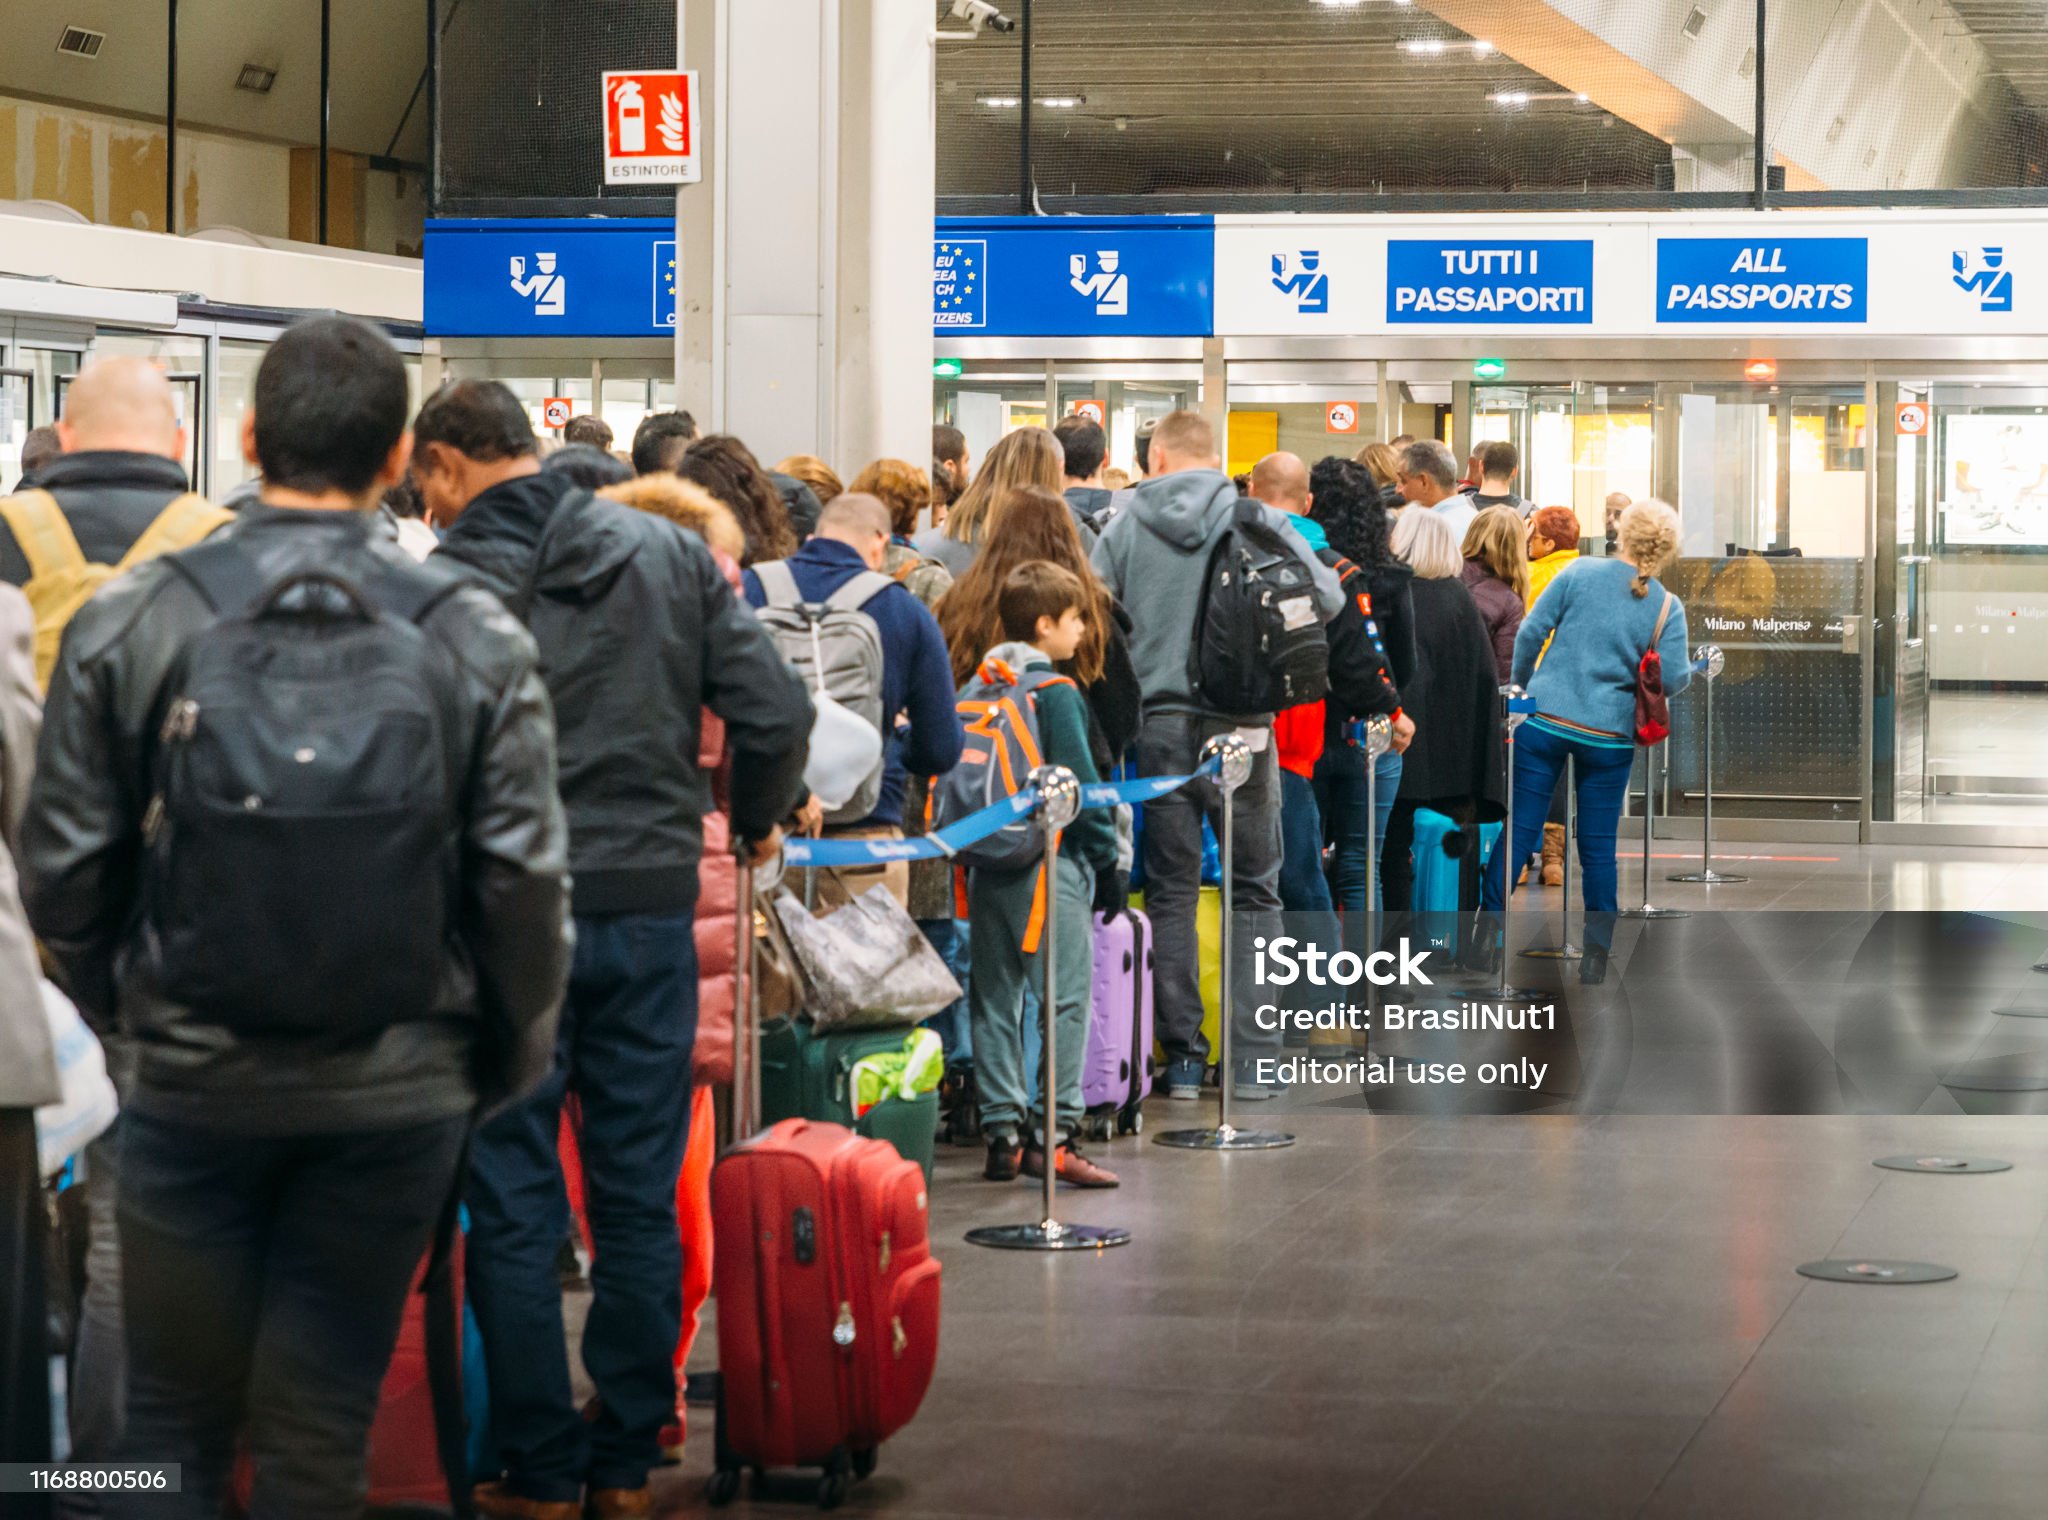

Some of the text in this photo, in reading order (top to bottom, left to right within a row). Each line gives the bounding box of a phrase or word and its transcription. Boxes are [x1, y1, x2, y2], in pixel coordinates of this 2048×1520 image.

[612, 164, 688, 177] ESTINTORE
[936, 256, 955, 267] EU
[1441, 250, 1537, 275] TUTTI I
[1730, 248, 1787, 273] ALL
[936, 284, 955, 295] CH
[1667, 283, 1853, 309] PASSPORTS
[1396, 287, 1584, 312] PASSAPORTI
[933, 312, 973, 324] TIZENS
[1704, 617, 1746, 631] Milano
[1752, 618, 1811, 633] Malpensa
